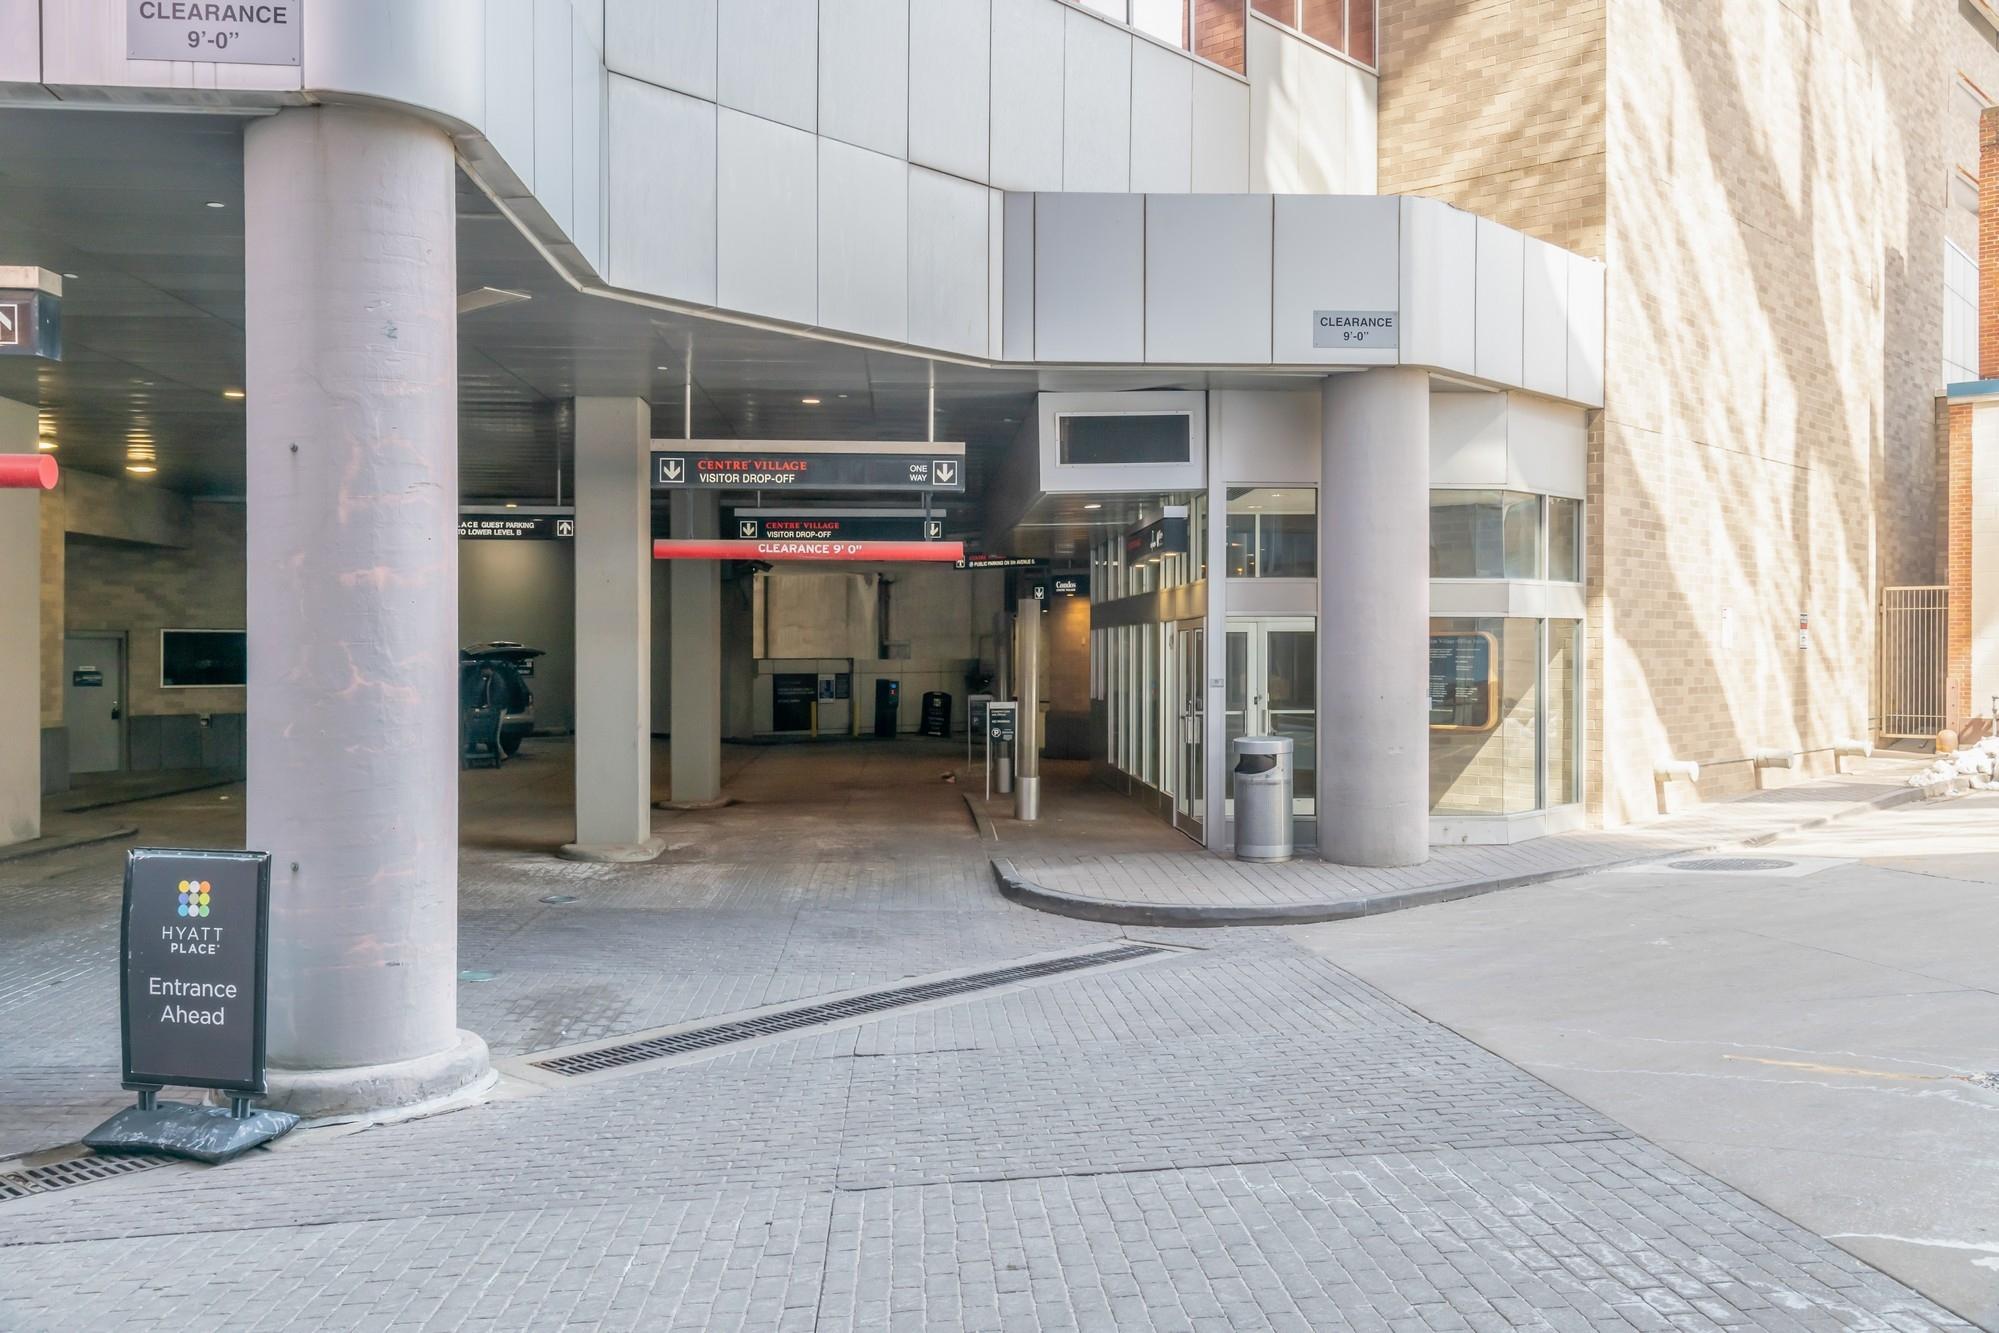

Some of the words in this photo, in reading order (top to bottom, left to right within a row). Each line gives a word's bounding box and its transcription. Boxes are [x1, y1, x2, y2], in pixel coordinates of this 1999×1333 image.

[139, 1, 288, 25] CLEARANCE
[1319, 316, 1393, 327] CLEARANCE
[697, 459, 749, 471] CENTRE
[754, 460, 808, 471] VILLAGE
[909, 464, 928, 473] ONE
[699, 473, 740, 483] VISITOR
[742, 473, 796, 483] DROP-OFF
[909, 474, 928, 482] WAY
[457, 521, 479, 529] ACE
[481, 521, 504, 529] GUEST
[758, 543, 830, 554] CLEARANCE
[833, 544, 845, 554] 9'
[162, 925, 224, 942] HYATT
[170, 942, 217, 955] PLACE
[149, 976, 237, 998] Entrance
[160, 1004, 225, 1025] Ahead
